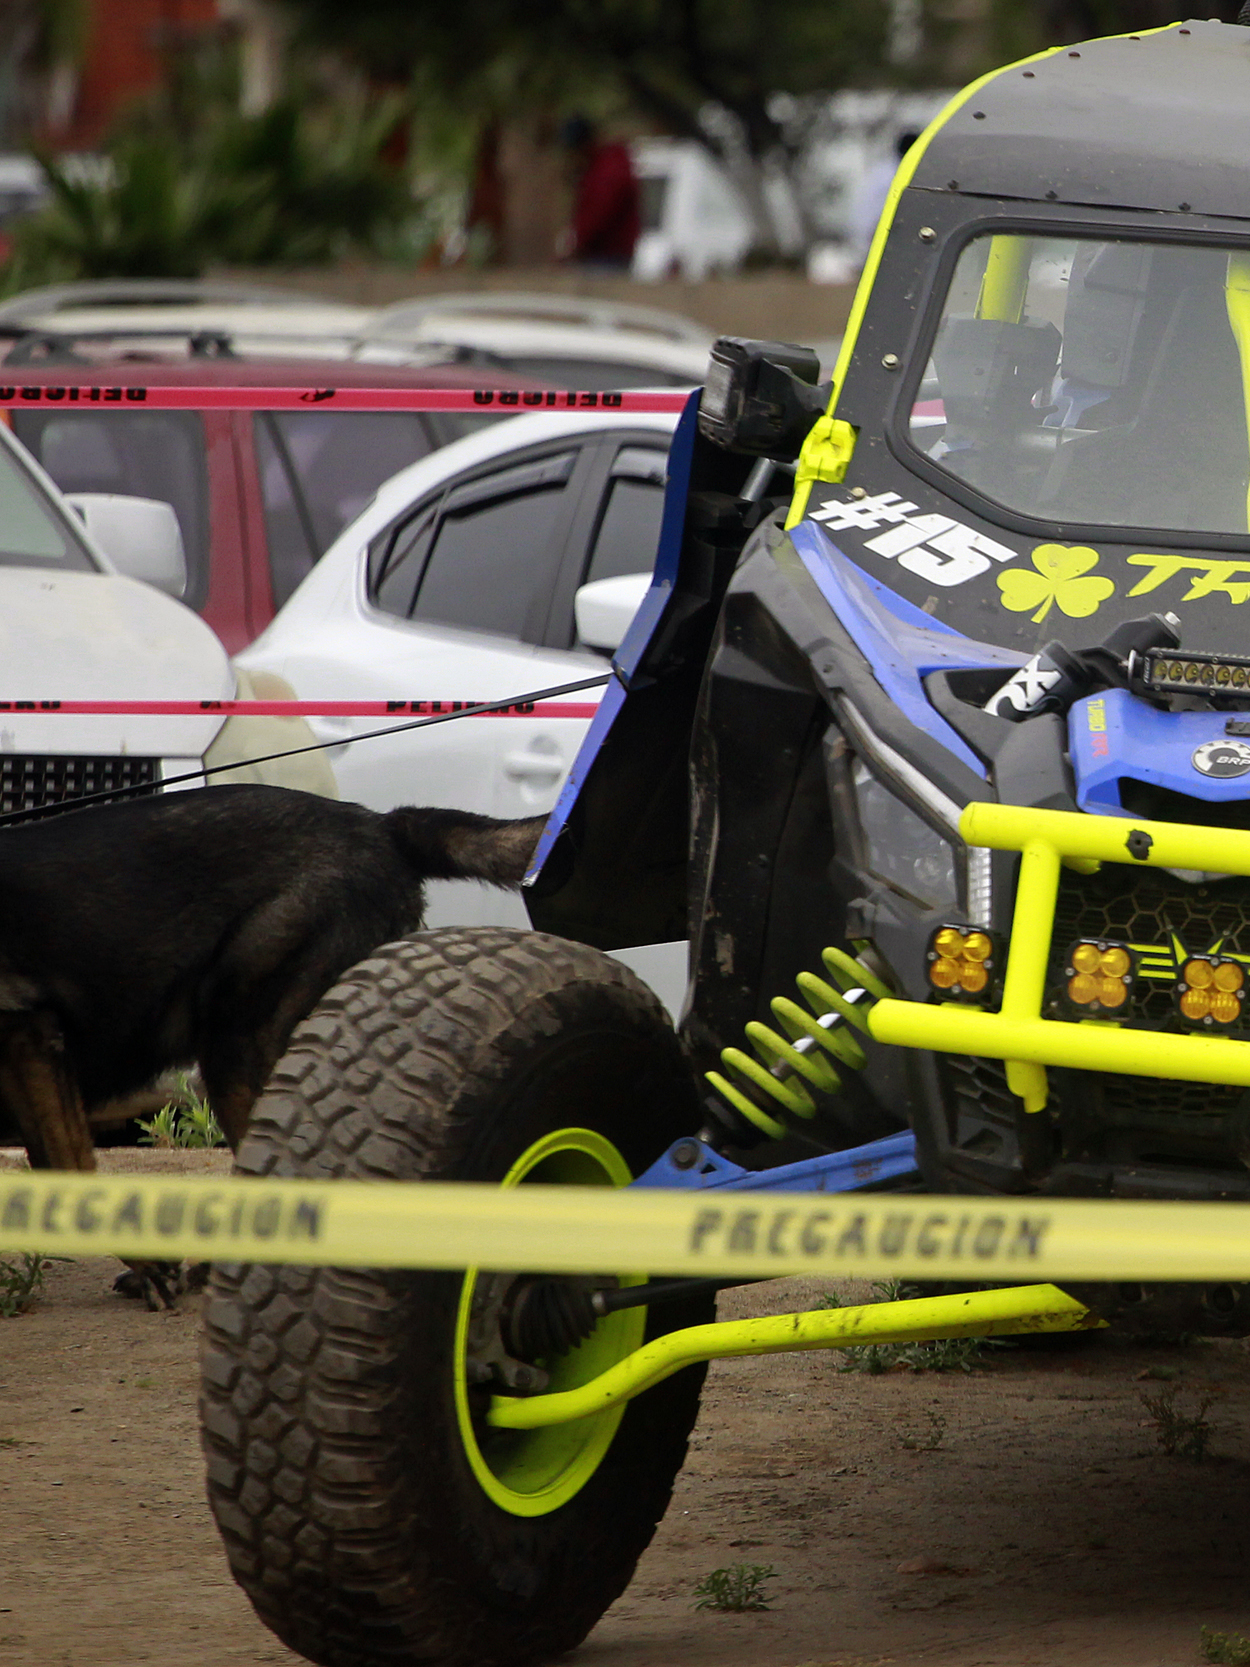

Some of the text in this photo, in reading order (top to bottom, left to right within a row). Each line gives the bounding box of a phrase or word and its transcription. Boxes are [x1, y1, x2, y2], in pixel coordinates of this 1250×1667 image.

[808, 491, 1019, 587] #15
[982, 654, 1062, 717] OX
[688, 1207, 1052, 1260] PRECAUCION
